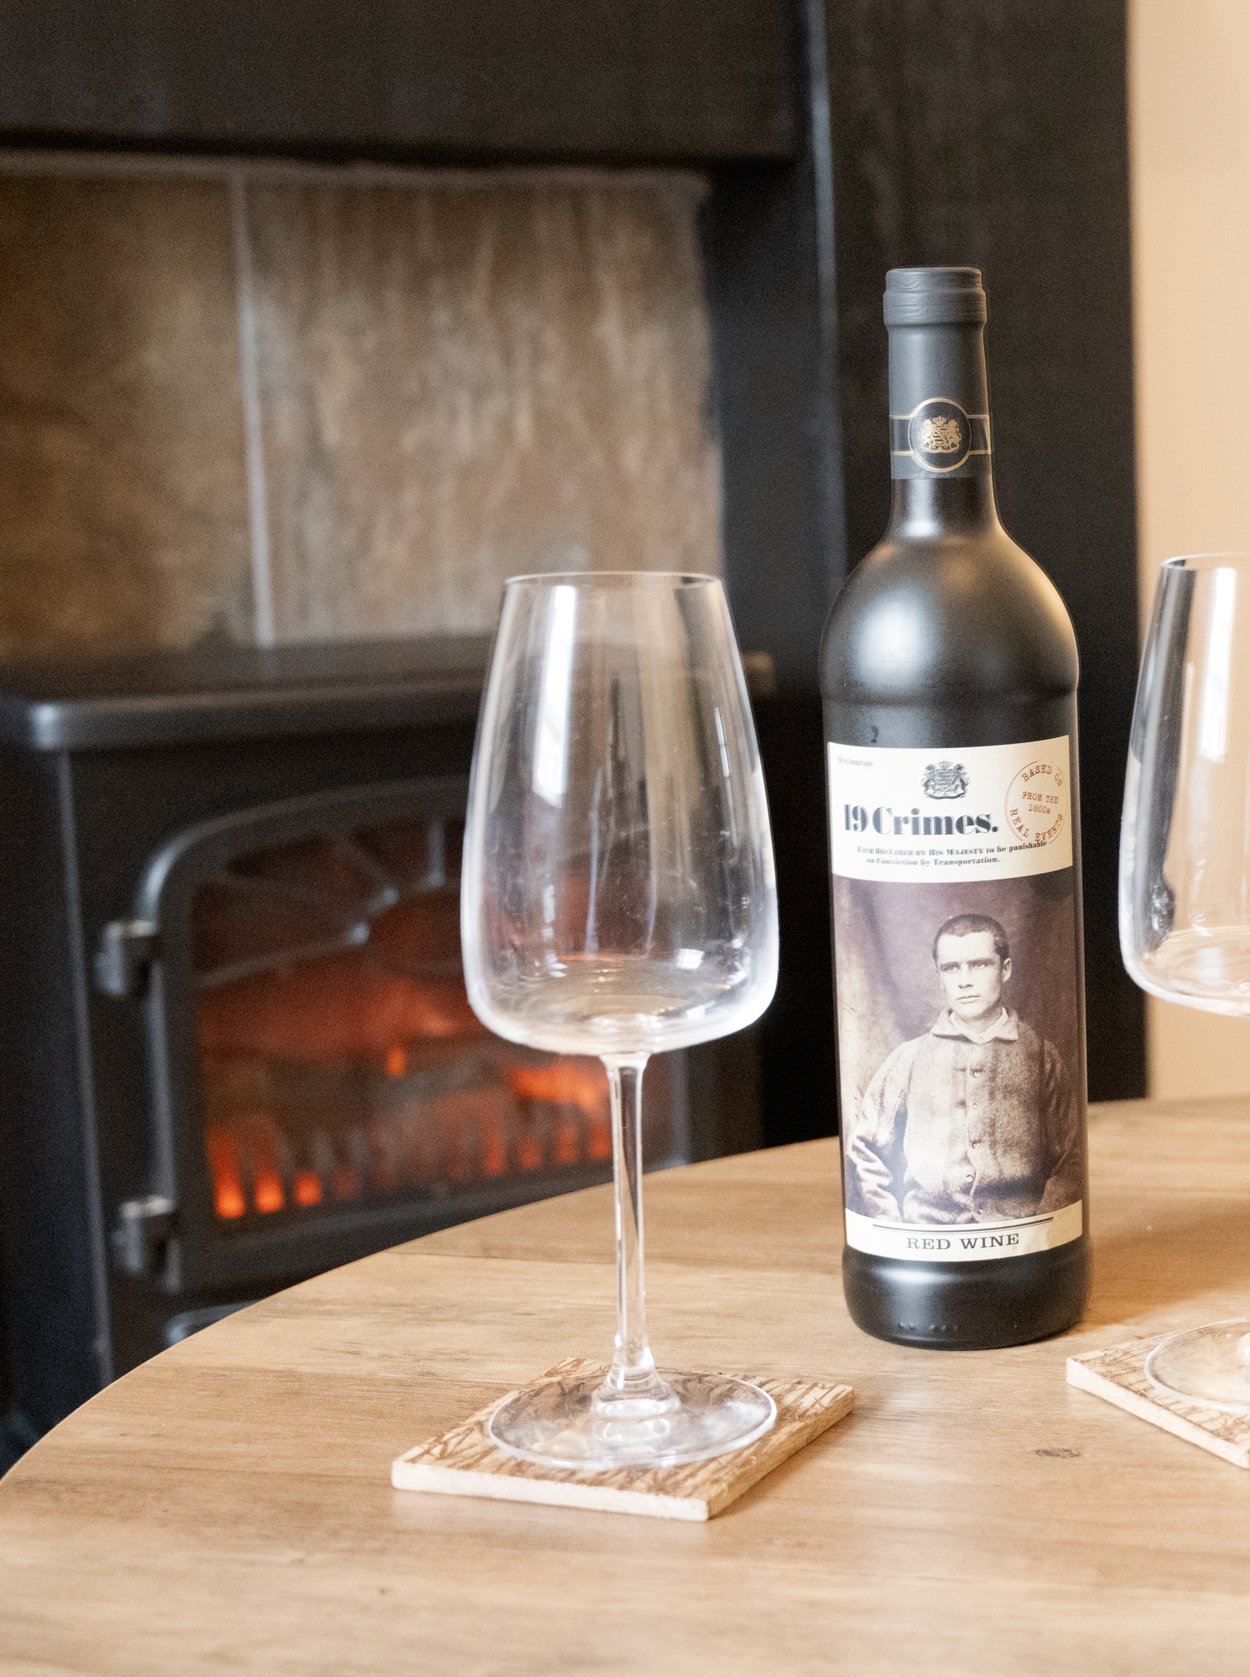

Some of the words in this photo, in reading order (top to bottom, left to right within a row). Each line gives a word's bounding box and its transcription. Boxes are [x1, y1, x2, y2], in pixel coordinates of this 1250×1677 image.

[1021, 764, 1052, 783] BASED
[1054, 773, 1063, 787] ON
[1022, 791, 1042, 802] FROM
[1045, 795, 1059, 804] THE
[1028, 803, 1051, 814] 1800s
[844, 804, 868, 833] 19
[872, 806, 998, 836] Crimes.
[1009, 808, 1030, 838] REAL
[1034, 814, 1063, 843] EVENTS
[997, 845, 1007, 853] be
[1009, 840, 1047, 853] punishable
[933, 857, 1000, 867] Transportation.
[906, 1237, 951, 1250] RED
[960, 1233, 1020, 1250] WINE
